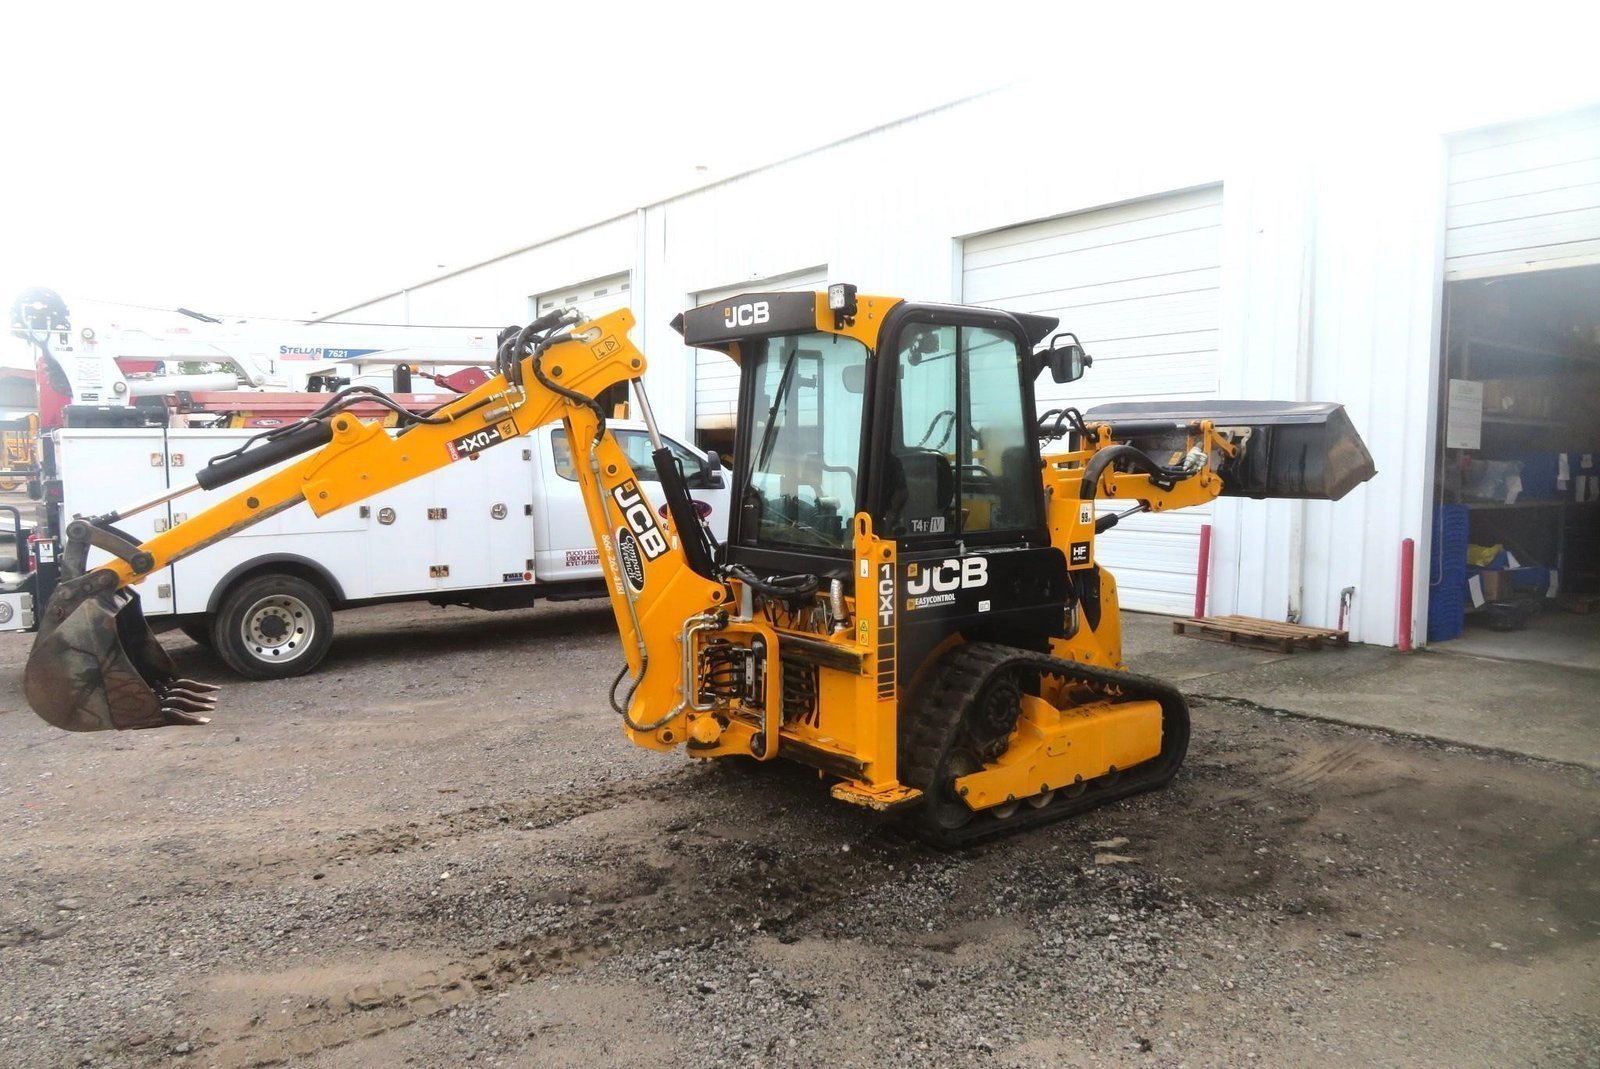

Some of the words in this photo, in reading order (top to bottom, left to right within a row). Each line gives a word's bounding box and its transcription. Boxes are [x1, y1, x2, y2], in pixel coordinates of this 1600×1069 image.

[725, 302, 770, 328] JCB
[328, 349, 348, 358] 7621
[457, 429, 499, 451] 1CXT
[614, 486, 666, 558] JCB
[620, 541, 636, 579] Wrench
[625, 535, 643, 583] Company
[1073, 546, 1086, 556] HF
[907, 557, 988, 595] JCB
[879, 564, 893, 625] 1CXT
[915, 593, 956, 606] EASYCONTROL
